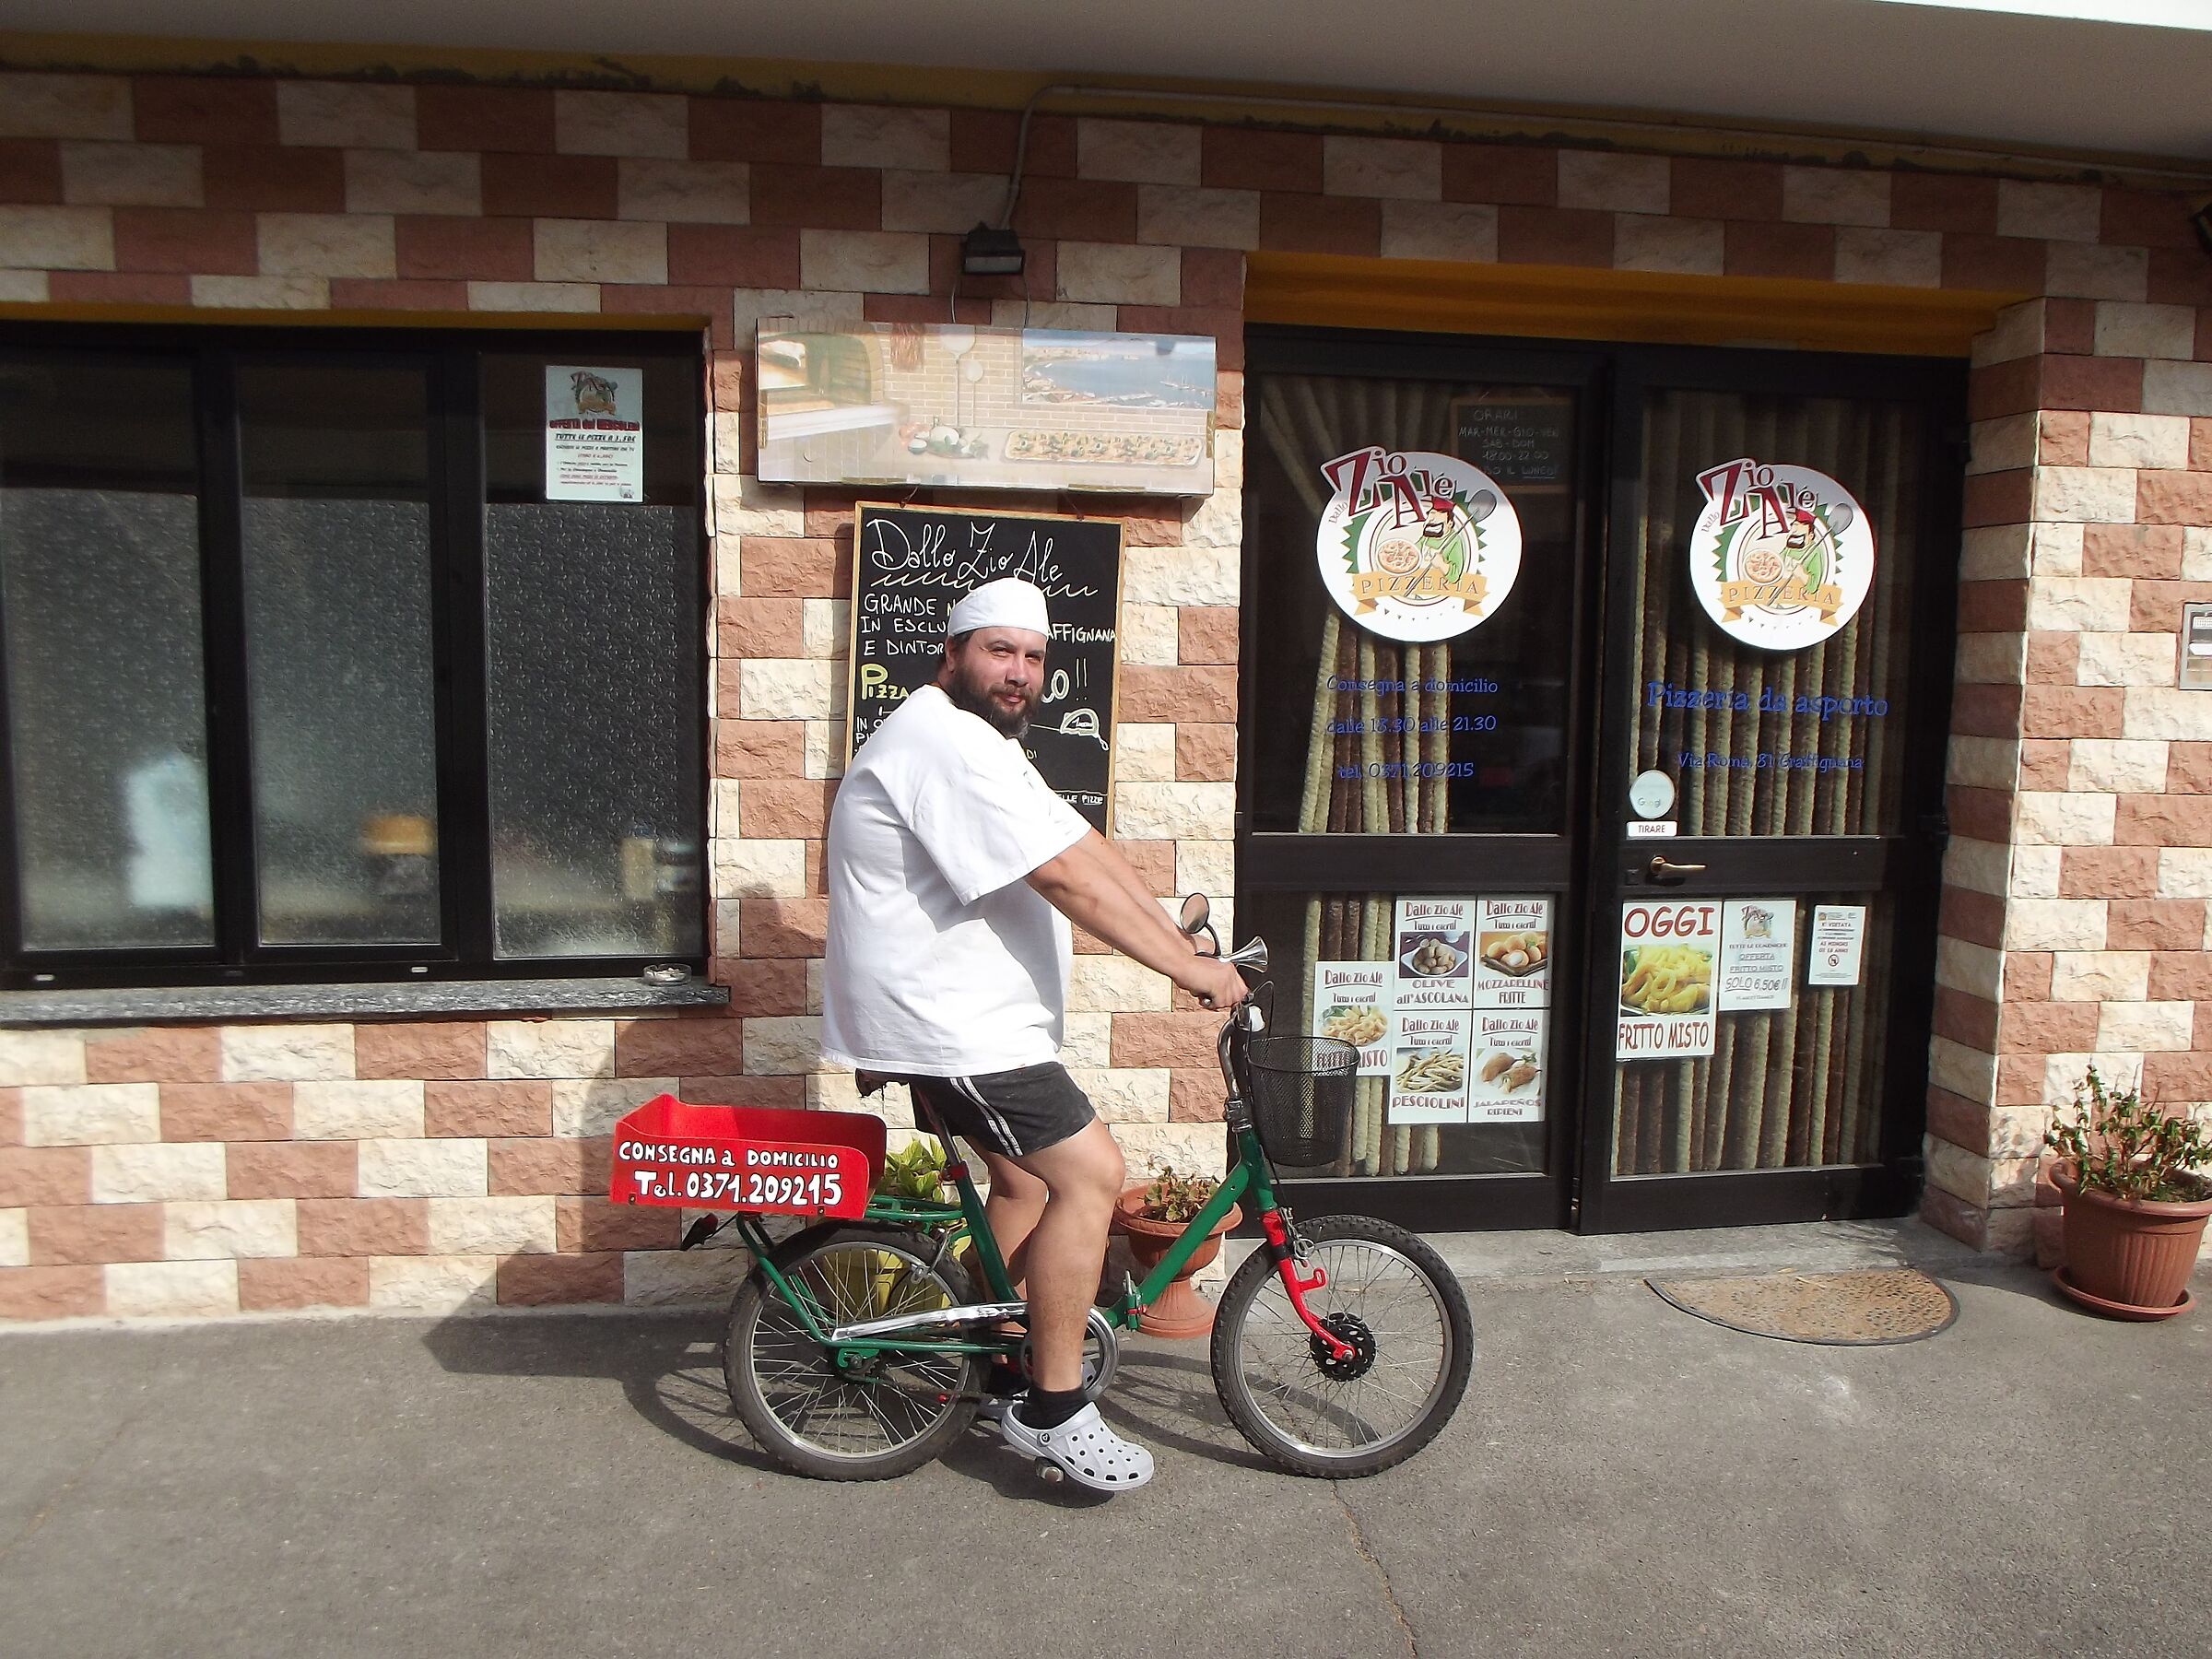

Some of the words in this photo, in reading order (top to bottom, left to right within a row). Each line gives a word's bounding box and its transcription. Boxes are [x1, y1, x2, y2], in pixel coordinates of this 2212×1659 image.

[1324, 450, 1407, 516] Zio
[1700, 462, 1774, 526] Zio
[866, 518, 957, 571] Dallo
[957, 521, 1015, 580] Zio
[1013, 530, 1064, 583] Ale
[1361, 576, 1479, 594] PIZZERIA
[1728, 586, 1835, 605] PIZZERIA
[865, 594, 937, 616] GRANDE
[861, 617, 881, 633] IN
[864, 640, 876, 655] E
[1327, 675, 1405, 696] Consegna
[1411, 679, 1419, 691] a
[1424, 677, 1499, 693] domicilio
[1647, 681, 1748, 712] Pizzeria
[1759, 687, 1786, 712] da
[1795, 694, 1889, 722] asporto
[1327, 717, 1364, 734] dalle
[1420, 717, 1447, 732] alle
[1453, 715, 1497, 732] 21.30
[1677, 752, 1702, 768] Via
[1638, 825, 1665, 833] TIRARE
[1406, 901, 1431, 917] Dallo
[1450, 903, 1464, 916] Ale
[1486, 900, 1512, 916] Dallo
[1530, 902, 1543, 915] Ale
[1624, 905, 1715, 938] OGGI
[1324, 969, 1351, 985] Dallo
[1370, 971, 1383, 984] Ale
[1412, 979, 1455, 989] OLIVE
[1725, 977, 1752, 989] SOLO
[1477, 979, 1550, 992] MOZZARELLINE
[1499, 991, 1526, 1005] FRITTE
[1402, 1017, 1429, 1033] Dallo
[1445, 1018, 1459, 1030] Ale
[1482, 1017, 1509, 1032] Dallo
[1525, 1018, 1538, 1030] Ale
[1618, 1022, 1664, 1051] FRITTO
[1668, 1021, 1709, 1049] MISTO
[1358, 1049, 1387, 1069] ISTO
[1392, 1095, 1465, 1110] PESCIOLINI
[1487, 1108, 1523, 1116] RIPIENI
[618, 1141, 716, 1165] CONSEGNA
[747, 1149, 839, 1169] DOMICILIO
[634, 1170, 682, 1197] Tel.
[686, 1171, 843, 1206] 0371.209215
